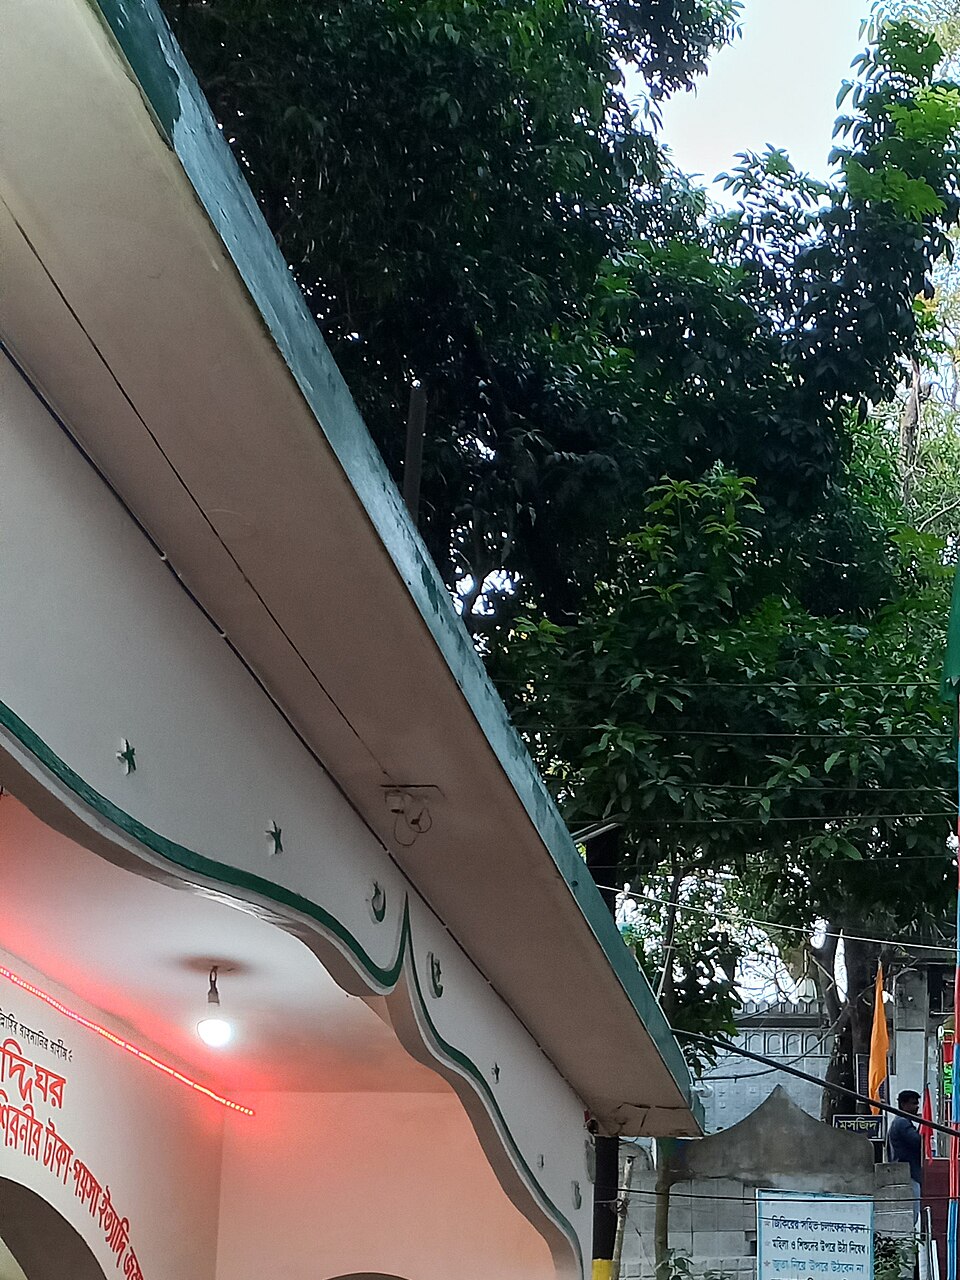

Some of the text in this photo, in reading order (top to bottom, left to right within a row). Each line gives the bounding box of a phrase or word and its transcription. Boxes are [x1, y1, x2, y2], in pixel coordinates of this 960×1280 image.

[35, 1064, 66, 1109] ঘর
[838, 1117, 878, 1131] মসজিদ
[99, 1185, 129, 1268] ইত্যাদি
[772, 1236, 789, 1250] মহিলা
[791, 1241, 796, 1250] ও
[819, 1239, 836, 1252] উপরে
[808, 1259, 828, 1272] উপরে
